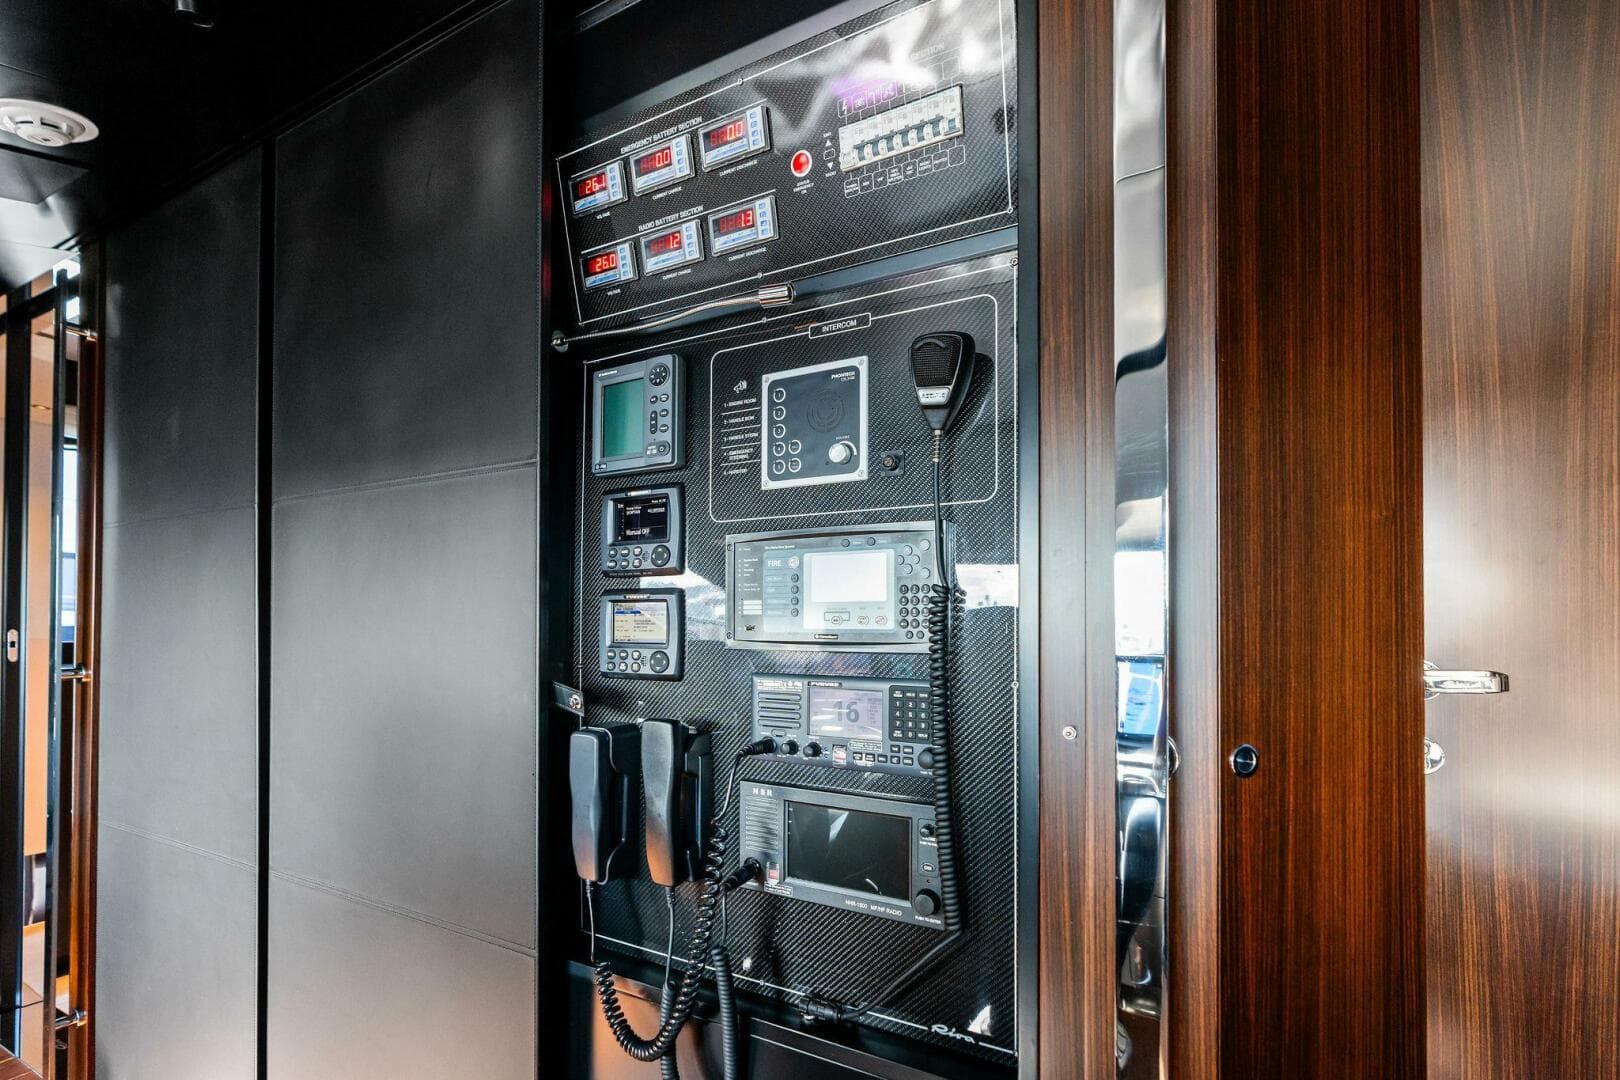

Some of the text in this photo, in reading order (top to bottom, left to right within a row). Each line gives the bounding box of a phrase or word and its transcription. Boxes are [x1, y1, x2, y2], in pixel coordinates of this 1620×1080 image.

[620, 116, 702, 154] EMERGENCY BATTERY SECTION
[638, 205, 704, 232] RADIO BATTERY SECTION
[595, 254, 616, 272] 26.0
[822, 319, 857, 333] INTERCOM
[832, 700, 860, 723] 16
[885, 907, 902, 917] RADIO
[930, 1023, 976, 1044] Riva
